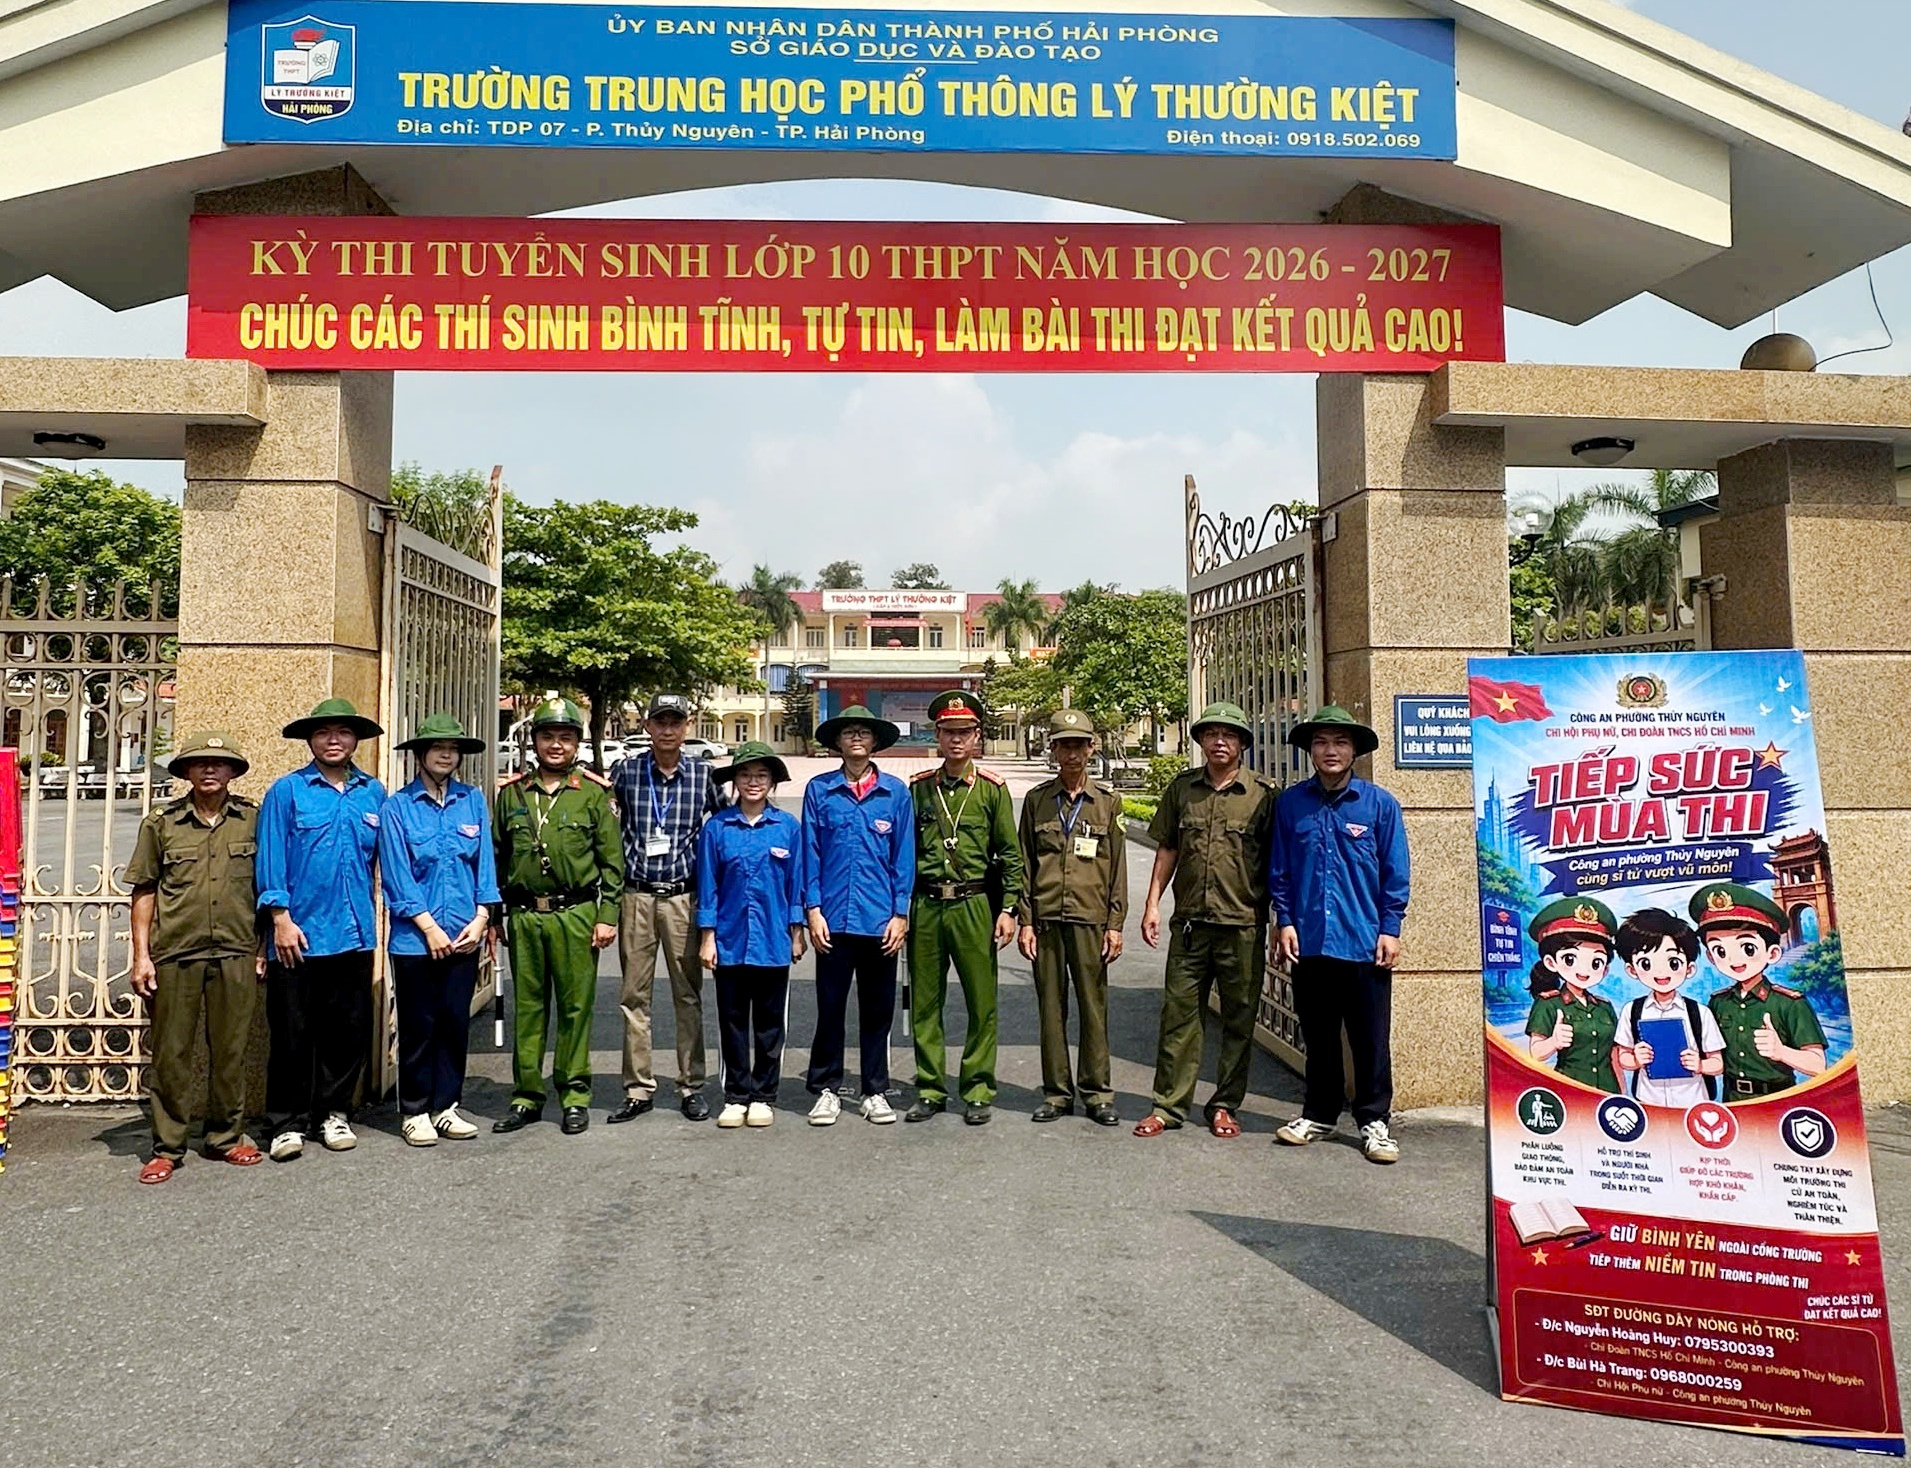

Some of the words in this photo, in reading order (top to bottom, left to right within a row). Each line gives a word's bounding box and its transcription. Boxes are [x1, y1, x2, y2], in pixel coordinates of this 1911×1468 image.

[608, 13, 646, 34] ỦY
[656, 20, 716, 35] BAN
[727, 19, 806, 36] NHÂN
[817, 19, 876, 37] DÂN
[886, 21, 983, 39] THÀNH
[995, 21, 1054, 40] PHỐ
[1063, 21, 1109, 41] HẢI
[1119, 25, 1219, 43] PHÒNG
[730, 36, 771, 55] SỞ
[779, 39, 850, 57] GIÁO
[859, 43, 918, 59] DỤC
[928, 41, 966, 58] VÀ
[975, 41, 1036, 59] ĐÀO
[1044, 45, 1102, 62] TẠO
[282, 102, 298, 114] HẢI
[301, 102, 333, 114] PHÒNG
[399, 66, 570, 111] TRƯỜNG
[585, 74, 726, 113] TRUNG
[741, 78, 825, 121] HỌC
[841, 67, 927, 116] PHỔ
[938, 75, 1077, 118] THÔNG
[1091, 76, 1138, 118] LÝ
[1151, 77, 1316, 121] THƯỜNG
[1331, 81, 1420, 130] KIỆT
[398, 119, 434, 137] Địa
[439, 119, 481, 136] chỉ:
[487, 121, 533, 136] TDP
[539, 122, 566, 137] 07
[587, 122, 604, 138] P.
[611, 121, 665, 140] Thủy
[672, 124, 754, 141] Nguyên
[775, 125, 807, 139] TP.
[815, 123, 849, 140] Hải
[856, 126, 925, 144] Phòng
[1167, 130, 1214, 146] Điện
[1221, 131, 1280, 147] thoại:
[1287, 133, 1421, 148] 0918.502.069
[250, 230, 320, 276] KỲ
[332, 241, 415, 277] THI
[428, 232, 587, 278] TUYỂN
[601, 243, 711, 279] SINH
[724, 234, 816, 280] LỚP
[828, 245, 870, 280] 10
[882, 245, 1002, 280] THPT
[1015, 236, 1120, 280] NĂM
[1132, 246, 1230, 290] HỌC
[1244, 247, 1330, 281] 2026
[1367, 248, 1452, 282] 2027
[239, 294, 338, 350] CHÚC
[350, 294, 423, 350] CÁC
[435, 295, 491, 350] THÍ
[502, 304, 589, 351] SINH
[602, 296, 687, 351] BÌNH
[699, 297, 792, 358] TĨNH,
[803, 302, 849, 362] TỰ
[857, 307, 925, 358] TIN,
[936, 298, 1011, 352] LÀM
[1022, 298, 1080, 352] BÀI
[1091, 308, 1145, 352] THI
[1155, 308, 1221, 362] ĐẠT
[1232, 294, 1294, 352] KẾT
[1306, 293, 1375, 357] QUẢ
[1385, 309, 1463, 352] CAO!
[1418, 706, 1436, 719] QUÝ
[1438, 706, 1470, 719] KHÁCH
[1570, 712, 1596, 723] CÔNG
[1600, 714, 1612, 722] AN
[1616, 711, 1656, 722] PHƯỜNG
[1686, 711, 1726, 722] NGUYÊN
[1404, 726, 1418, 737] VUI
[1546, 728, 1561, 737] CHI
[1564, 727, 1579, 738] HỘI
[1582, 728, 1600, 739] PHỤ
[1622, 728, 1637, 737] CHI
[1640, 725, 1665, 737] ĐOÀN
[1668, 727, 1692, 737] TNCS
[1711, 725, 1727, 736] CHÍ
[1730, 726, 1756, 737] MINH
[1437, 743, 1454, 755] QUA
[1530, 746, 1638, 808] TIẾP
[1649, 743, 1753, 792] SỨC
[1550, 797, 1670, 849] MÙA
[1679, 791, 1769, 837] THI
[1569, 860, 1600, 872] Công
[1602, 859, 1616, 868] an
[1618, 853, 1662, 868] phường
[1665, 848, 1693, 862] Thủy
[1695, 846, 1740, 861] Nguyên
[1576, 872, 1609, 886] cùng
[1612, 870, 1623, 882] sĩ
[1627, 868, 1643, 880] tử
[1646, 866, 1675, 880] vượt
[1679, 864, 1695, 876] vũ
[1698, 861, 1733, 875] môn!
[1610, 1223, 1639, 1243] GIỮ
[1642, 1226, 1681, 1248] BÌNH
[1686, 1231, 1716, 1251] YÊN
[1719, 1241, 1750, 1255] NGOÀI
[1752, 1242, 1780, 1258] CỔNG
[1782, 1247, 1823, 1263] TRƯỜNG
[1589, 1253, 1611, 1267] TIẾP
[1614, 1256, 1641, 1270] THÊM
[1645, 1252, 1686, 1275] NIỀM
[1690, 1260, 1716, 1279] TIN
[1720, 1269, 1753, 1283] TRONG
[1756, 1272, 1790, 1288] PHÒNG
[1792, 1276, 1809, 1290] THI
[1832, 1295, 1850, 1306] CÁC
[1841, 1307, 1859, 1319] QUẢ
[1861, 1308, 1882, 1318] CAO!
[1585, 1304, 1610, 1318] SĐT
[1614, 1307, 1662, 1324] ĐƯỜNG
[1666, 1312, 1693, 1328] DÂY
[1766, 1326, 1800, 1343] TRỢ:
[1542, 1318, 1562, 1332] Đ/c
[1612, 1327, 1650, 1344] Hoàng
[1653, 1332, 1681, 1348] Huy:
[1685, 1336, 1775, 1358] 0795300393
[1632, 1347, 1658, 1359] TNCS
[1544, 1354, 1565, 1368] Đ/c
[1567, 1357, 1587, 1371] Bùi
[1590, 1360, 1607, 1373] Hà
[1609, 1362, 1648, 1380] Trang:
[1651, 1368, 1743, 1391] 0968000259
